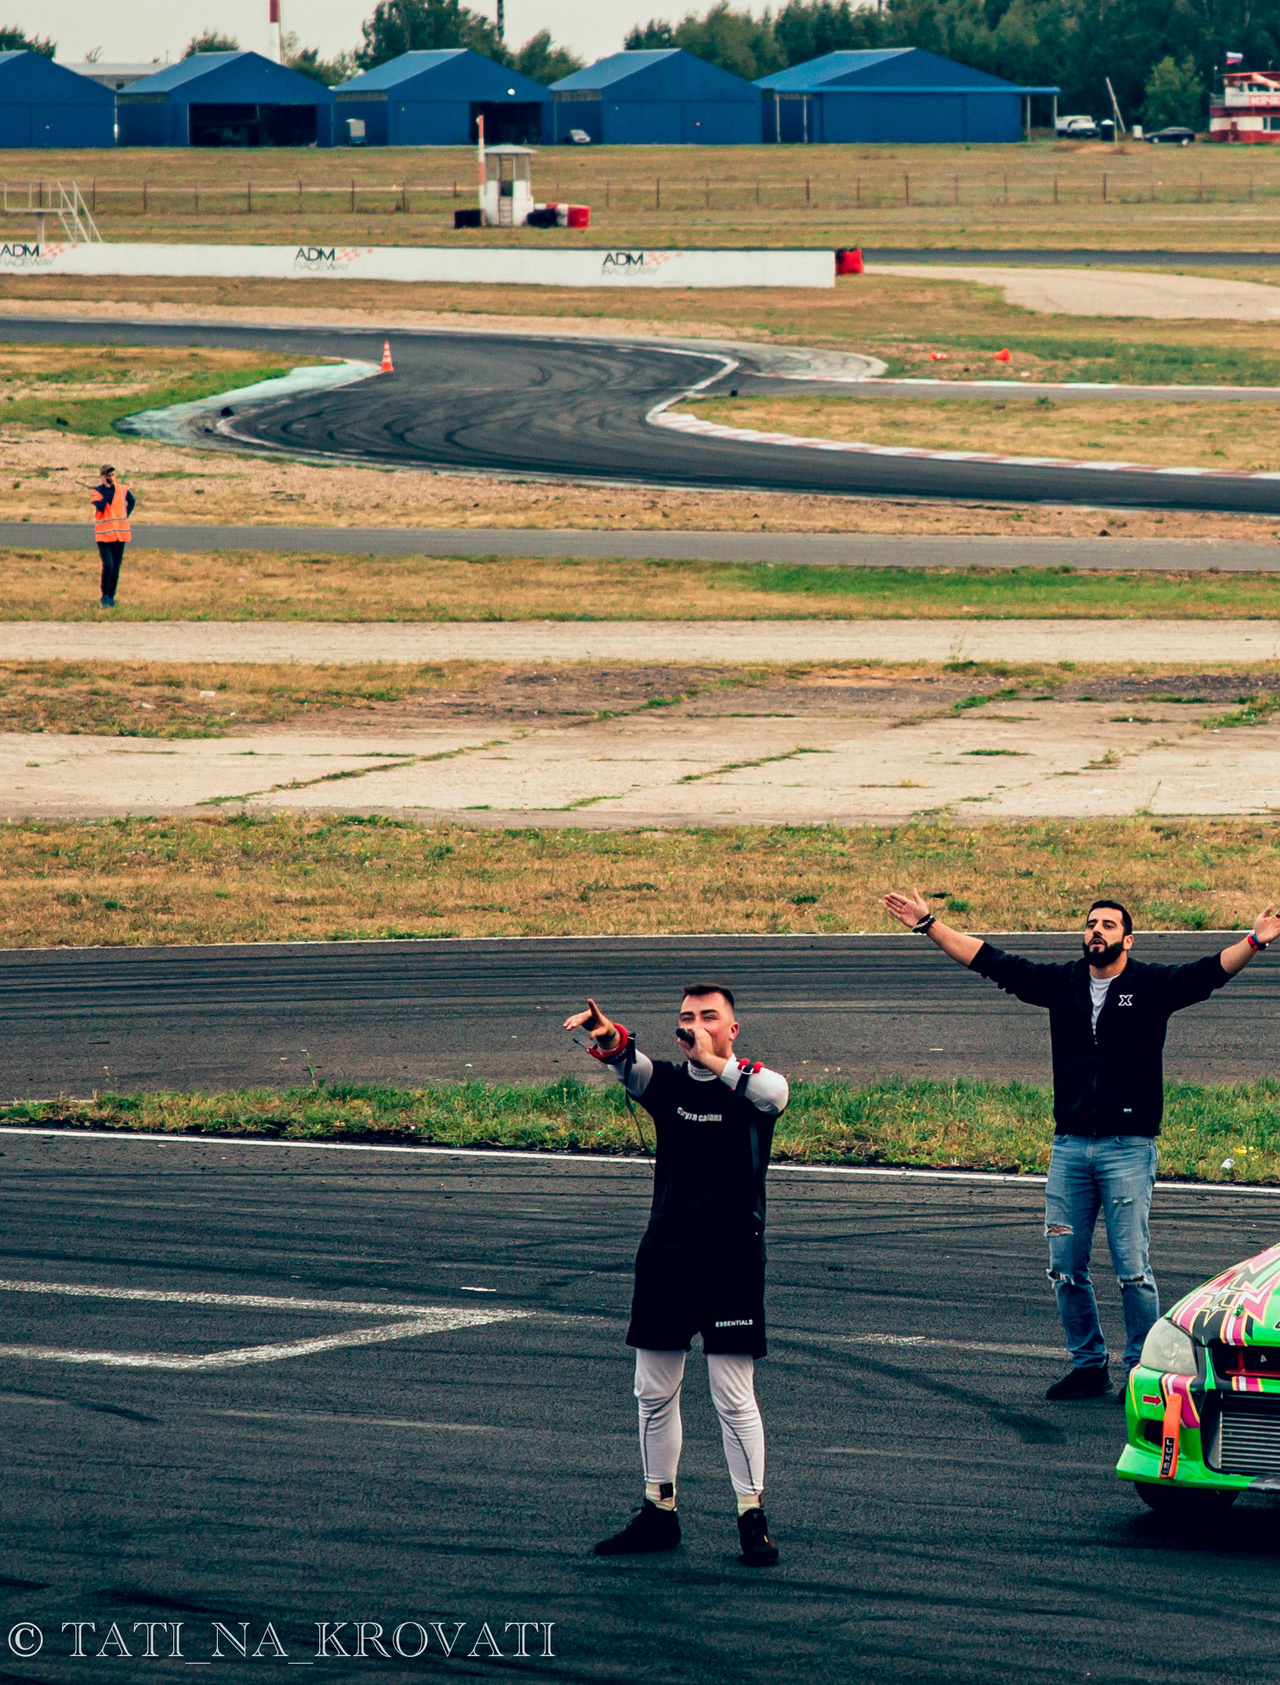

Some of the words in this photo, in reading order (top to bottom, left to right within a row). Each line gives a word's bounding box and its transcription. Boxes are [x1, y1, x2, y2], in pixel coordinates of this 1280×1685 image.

[0, 244, 40, 257] ADM
[295, 247, 336, 261] ADM
[602, 252, 644, 266] ADM
[715, 1319, 753, 1328] ESSENTIALS
[1163, 1438, 1173, 1469] LUKE
